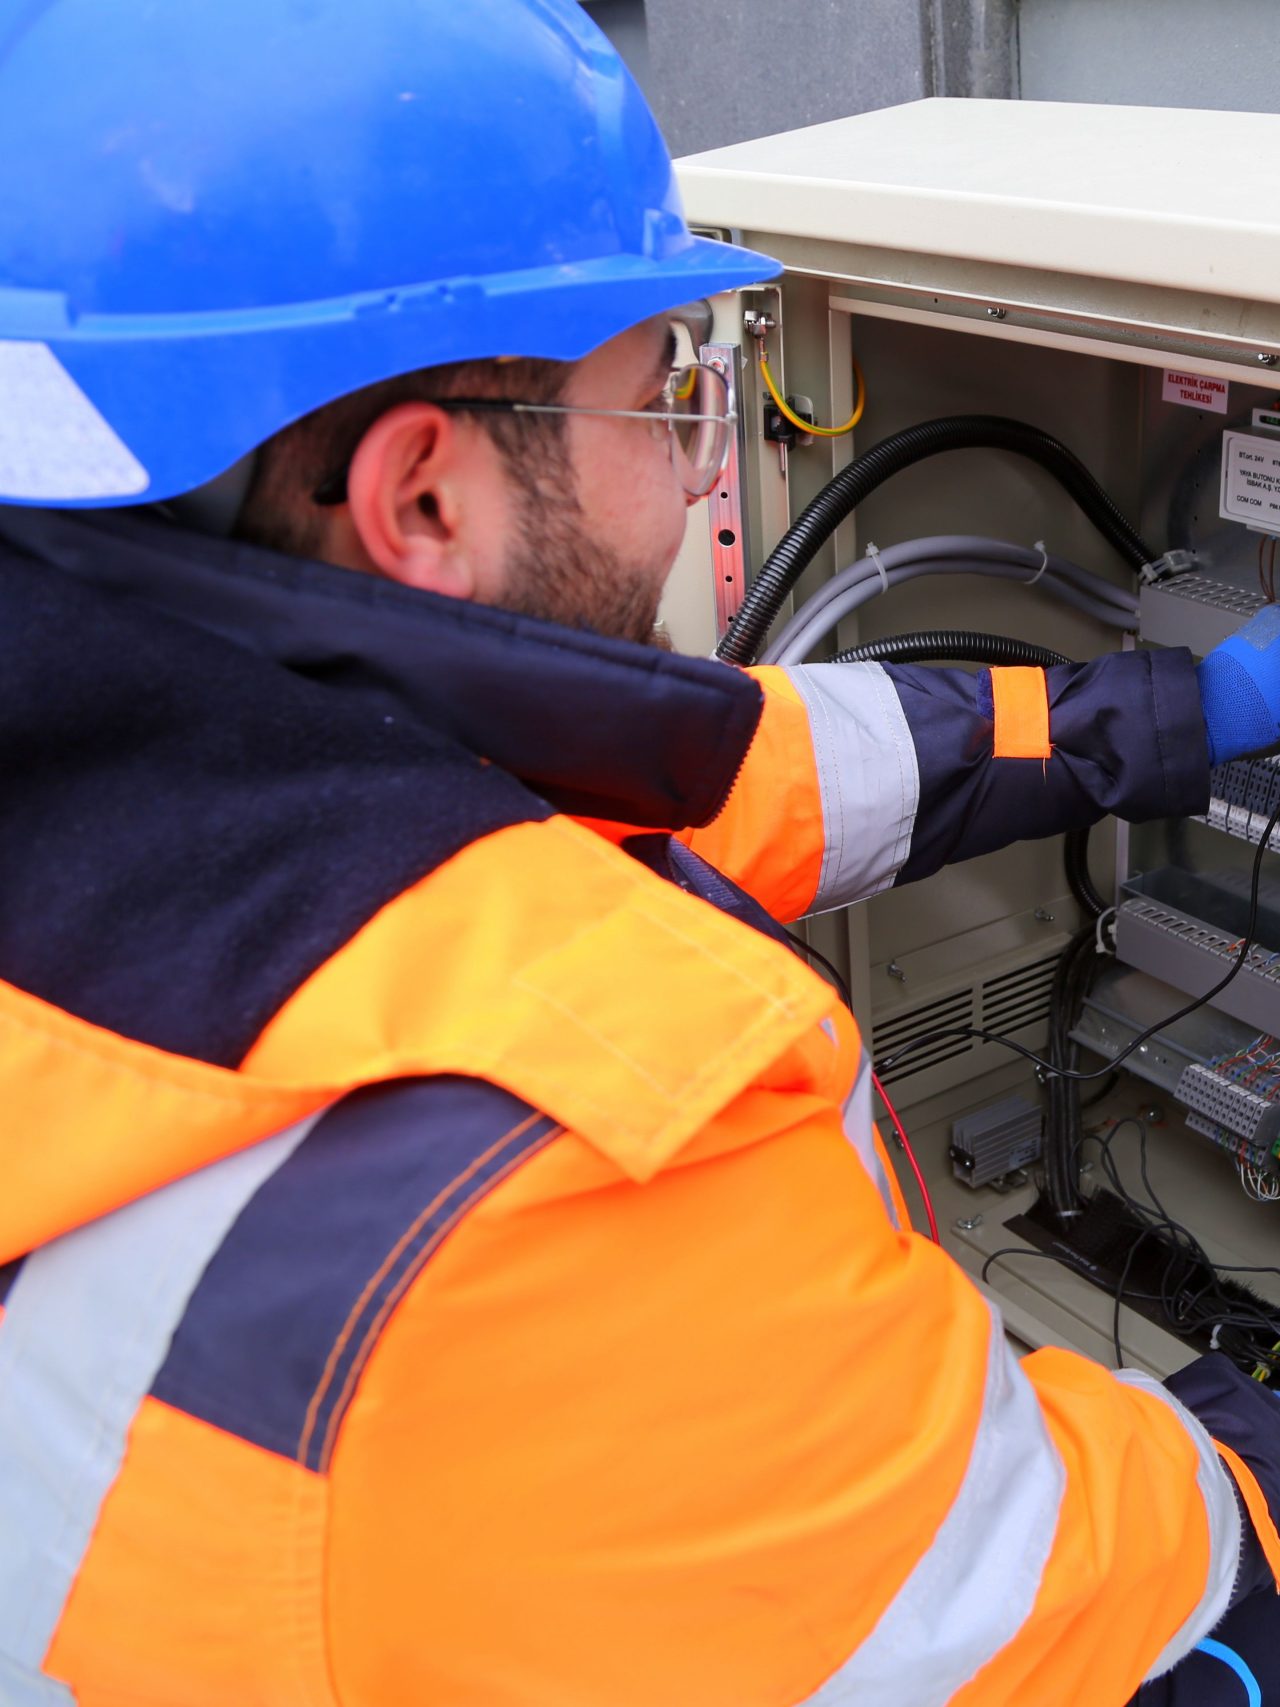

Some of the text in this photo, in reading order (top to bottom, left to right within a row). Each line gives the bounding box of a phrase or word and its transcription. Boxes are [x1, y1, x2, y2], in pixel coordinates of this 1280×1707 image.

[1168, 374, 1226, 394] ELEKTRİK ÇARPMA
[1180, 389, 1212, 404] TEHLİKESİ
[1254, 455, 1265, 463] 24V
[1253, 472, 1275, 483] BUTONU
[1237, 495, 1249, 503] COM
[1250, 498, 1262, 506] COM
